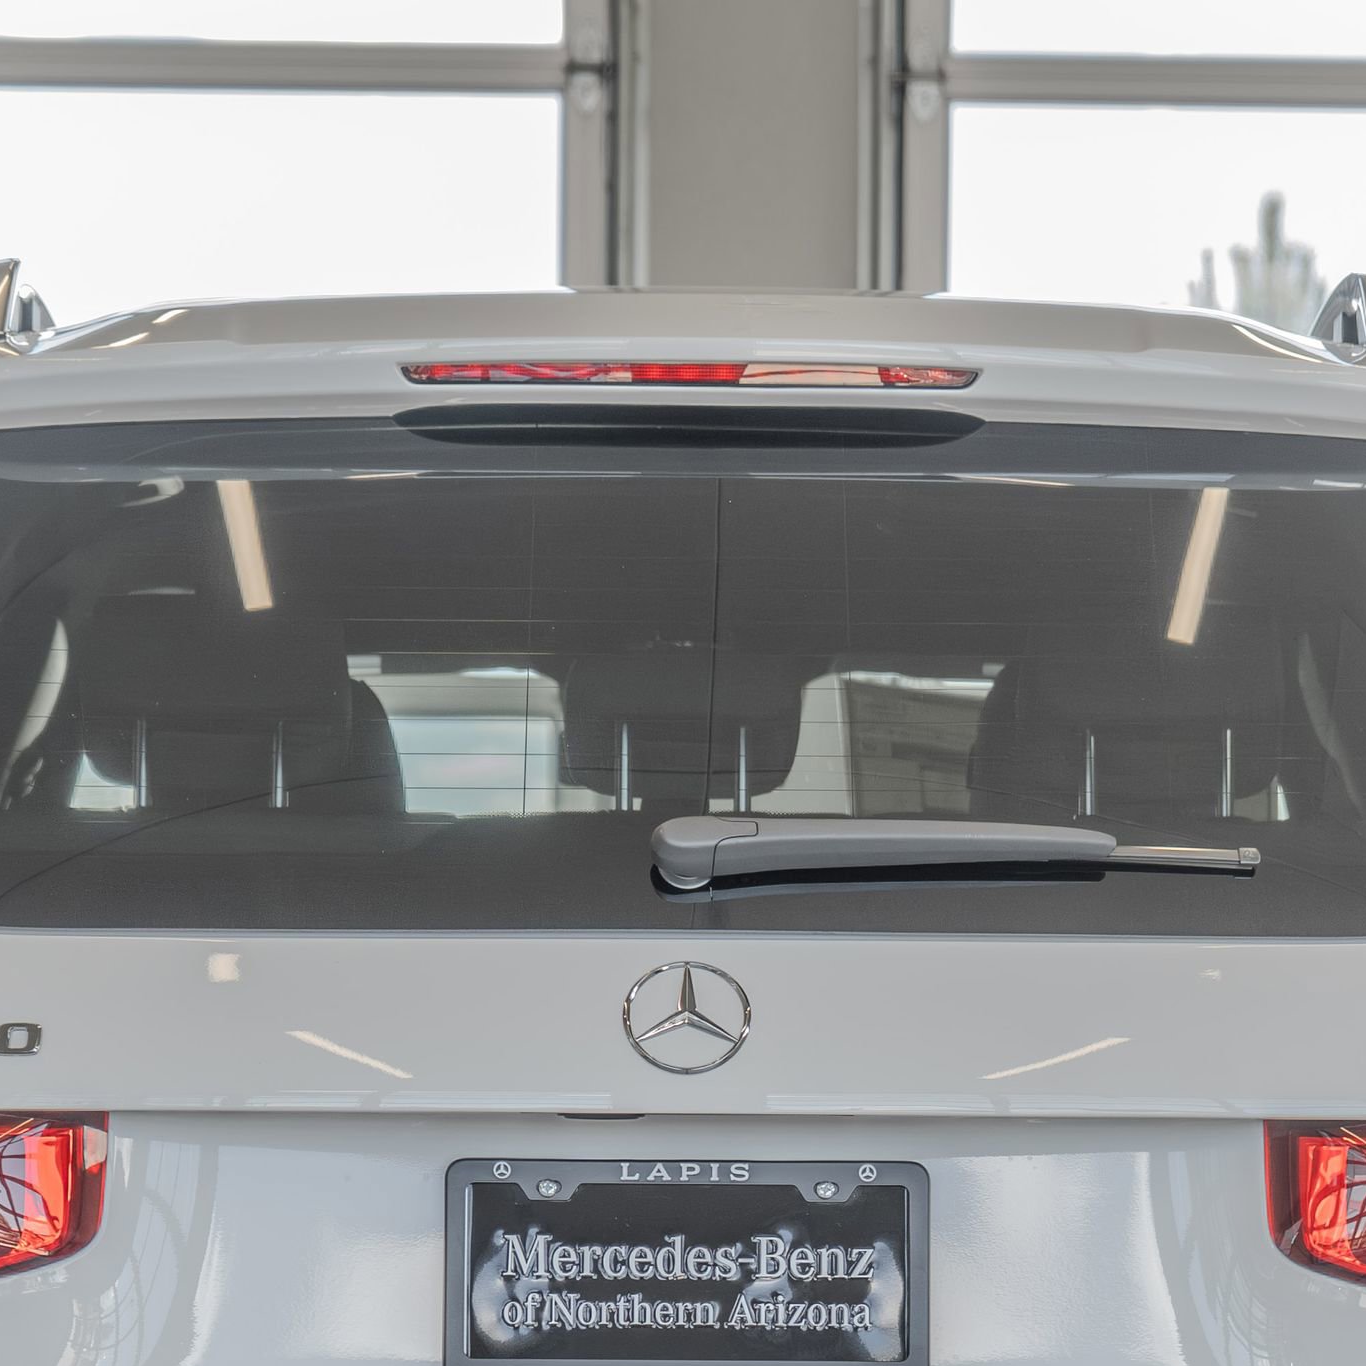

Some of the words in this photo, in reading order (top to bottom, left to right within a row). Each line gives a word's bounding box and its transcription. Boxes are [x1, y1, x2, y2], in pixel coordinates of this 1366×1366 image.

[620, 1163, 750, 1182] LAPIS
[501, 1233, 875, 1280] Mercedes-Benz
[502, 1292, 540, 1328] of
[549, 1292, 721, 1328] Northern
[728, 1294, 872, 1329] Arizona
